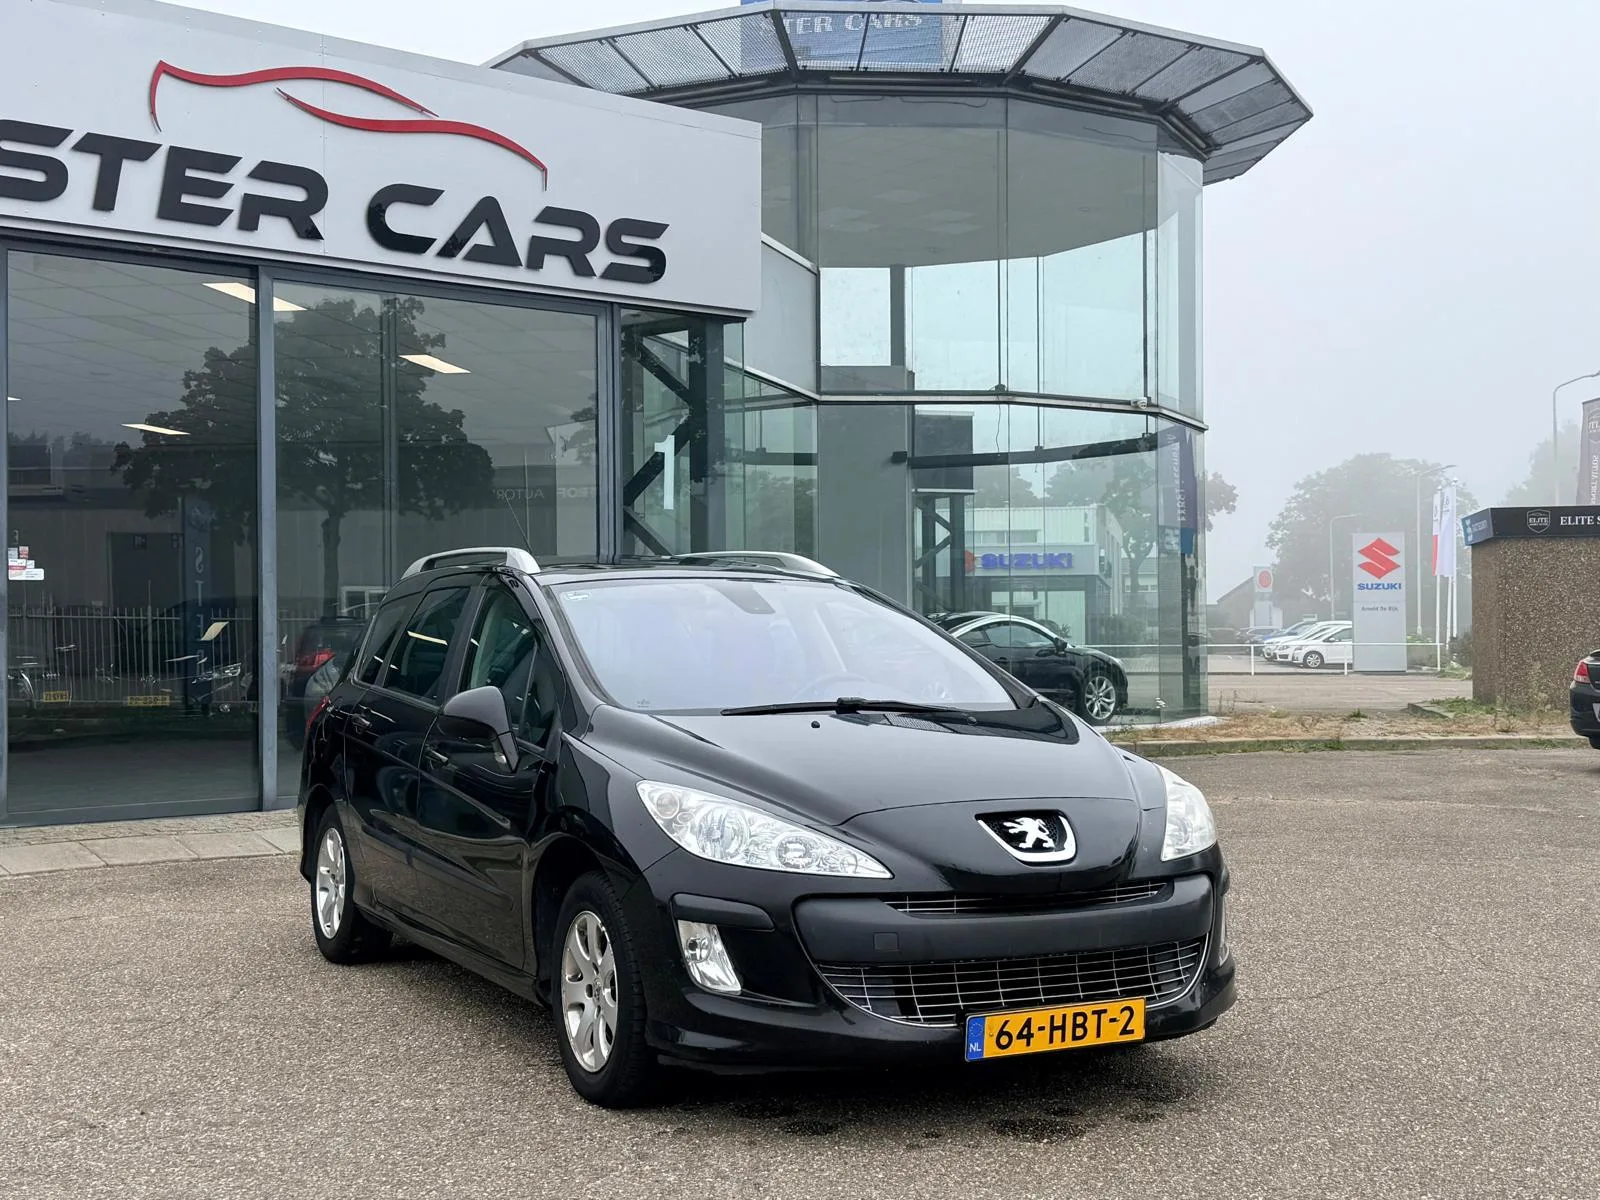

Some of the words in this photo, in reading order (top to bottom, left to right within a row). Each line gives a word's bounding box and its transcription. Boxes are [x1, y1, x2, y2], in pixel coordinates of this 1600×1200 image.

[0, 119, 329, 240] STER
[367, 183, 670, 284] CARS
[654, 434, 675, 510] 1
[1560, 515, 1594, 526] ELITE
[981, 552, 1073, 570] SUZUKI
[1357, 582, 1402, 591] SUZUKI
[995, 1005, 1135, 1051] 64-HBT-2
[969, 1043, 982, 1052] NL
